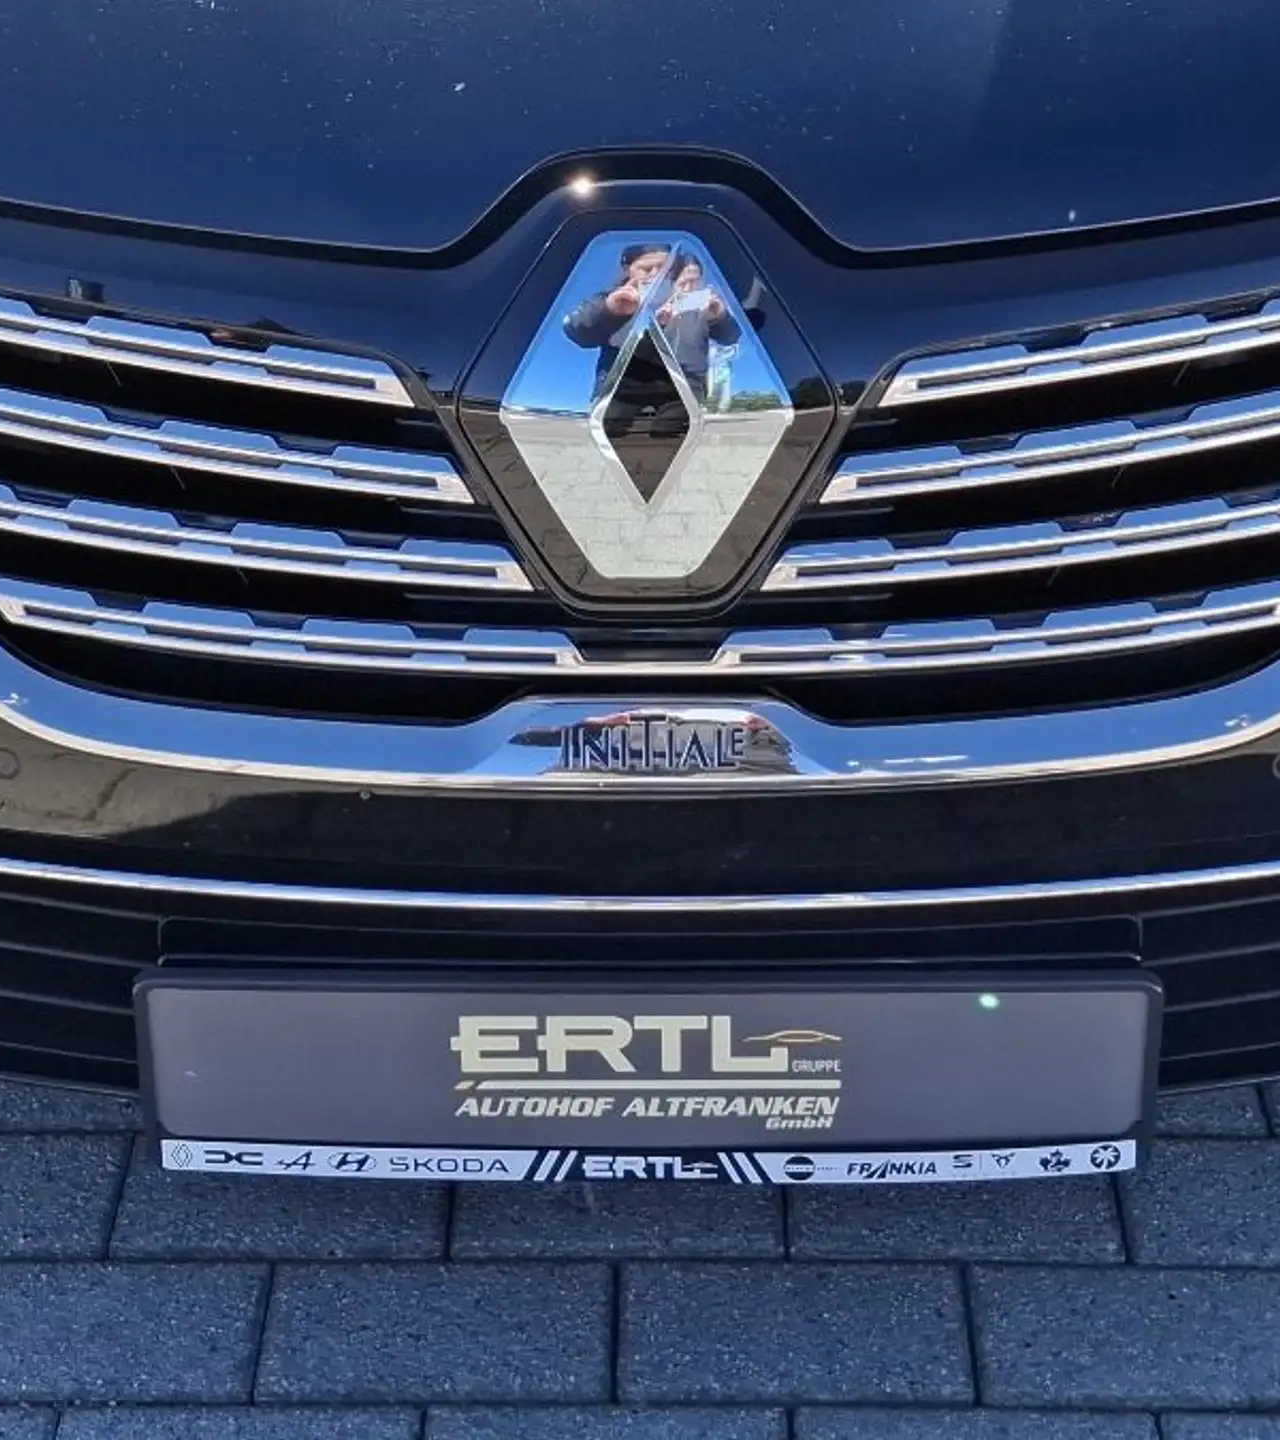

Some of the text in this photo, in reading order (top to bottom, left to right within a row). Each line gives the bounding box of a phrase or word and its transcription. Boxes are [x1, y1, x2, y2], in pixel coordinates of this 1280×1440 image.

[560, 713, 745, 771] INITIALE
[450, 1014, 789, 1073] ERTL
[791, 1059, 842, 1074] GRUPPE
[454, 1095, 841, 1118] AUTOHOF ALTFRANKEN
[765, 1116, 834, 1131] GmbH
[582, 1155, 718, 1180] ERTL
[846, 1159, 937, 1179] FRANKIA
